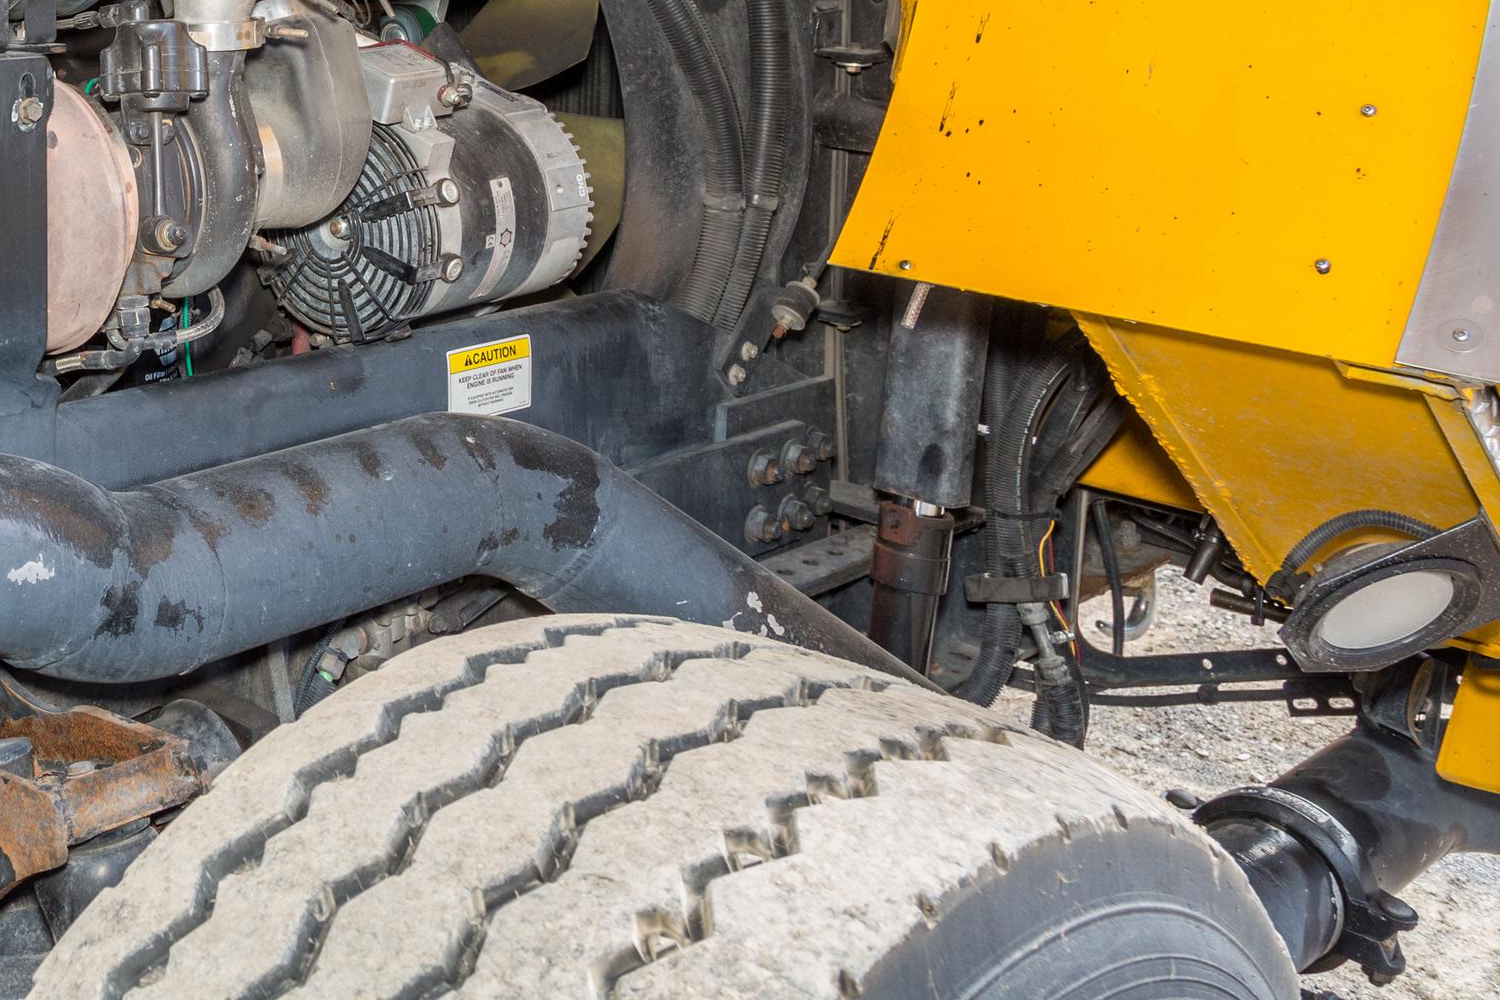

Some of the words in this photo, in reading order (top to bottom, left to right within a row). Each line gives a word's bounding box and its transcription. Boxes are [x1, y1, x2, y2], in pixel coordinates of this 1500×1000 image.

[576, 174, 586, 197] GND
[473, 345, 516, 364] CAUTION
[472, 371, 489, 381] CLEAR
[467, 379, 486, 389] ENGINE
